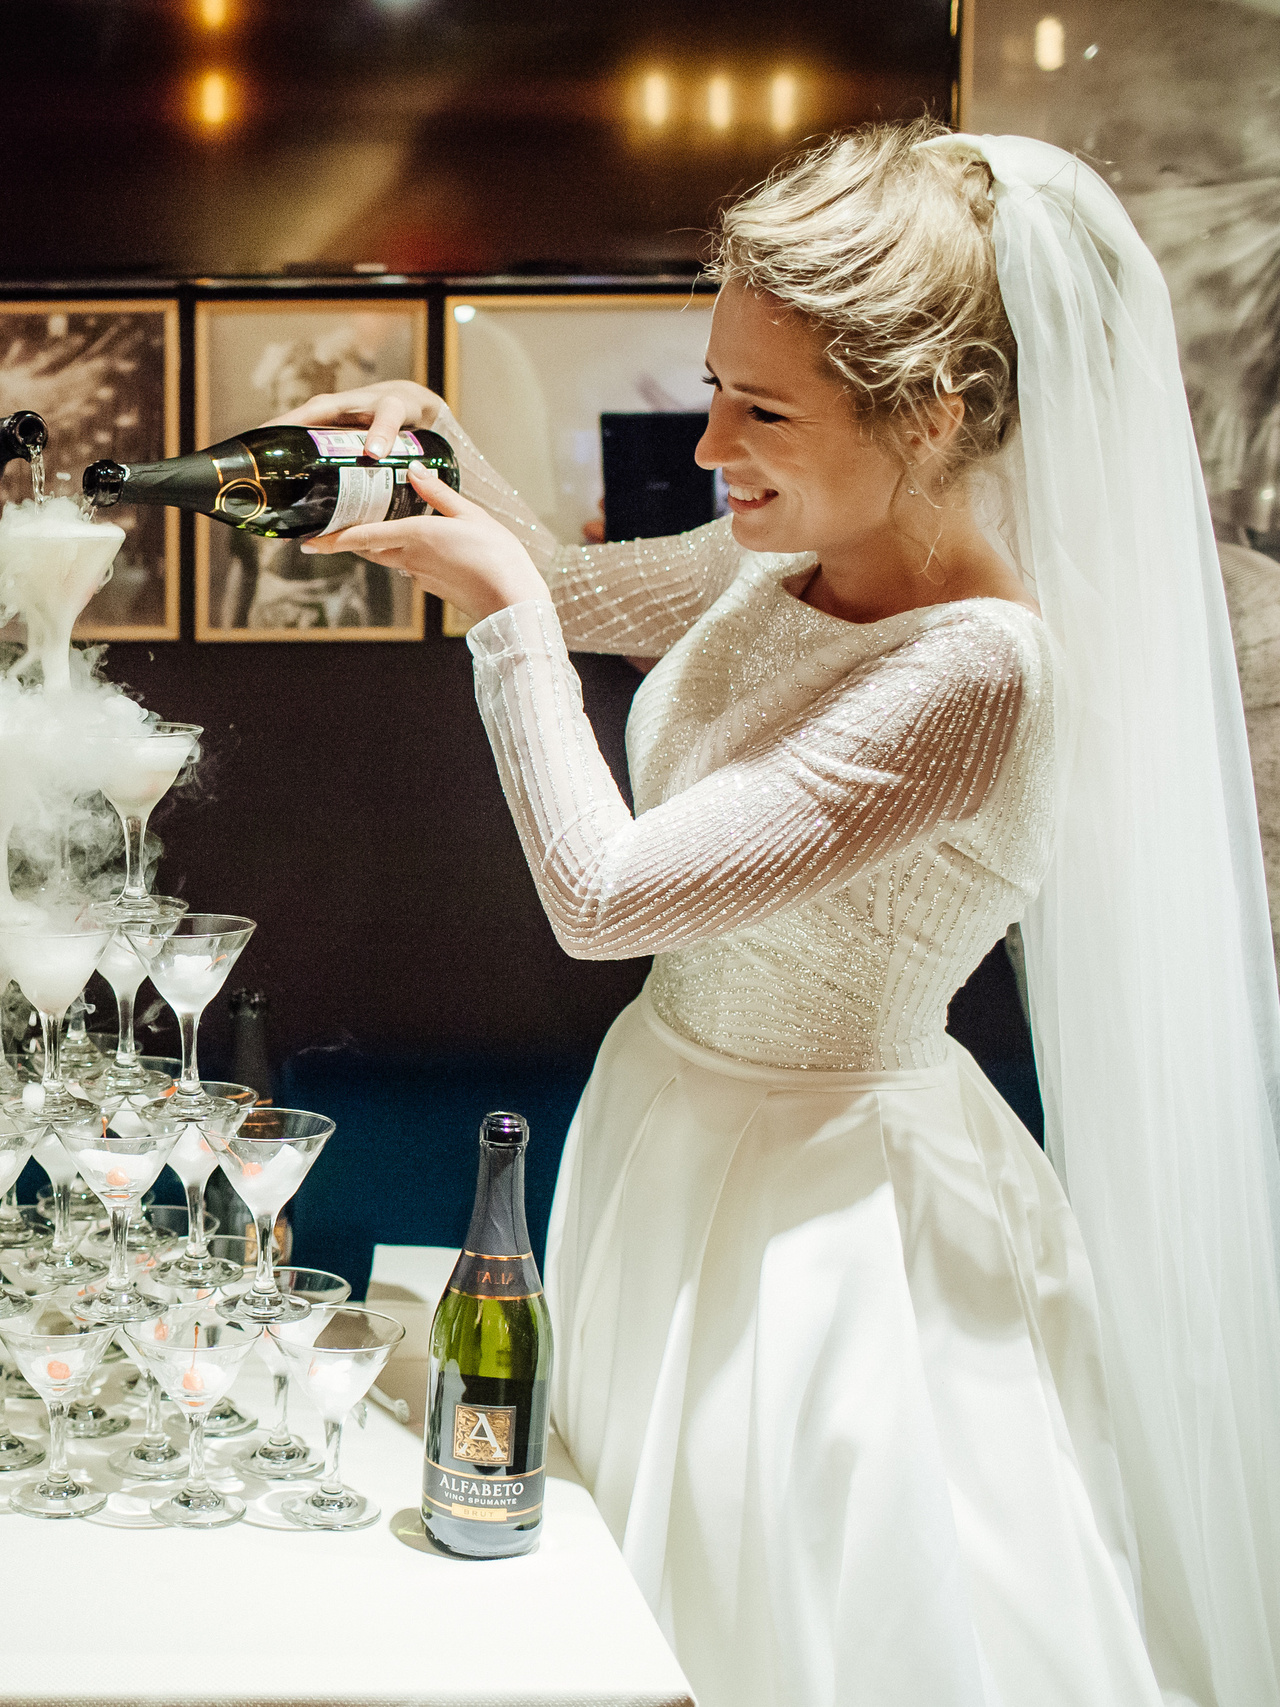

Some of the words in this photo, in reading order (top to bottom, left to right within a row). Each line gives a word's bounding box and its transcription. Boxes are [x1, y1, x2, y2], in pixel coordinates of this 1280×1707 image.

[458, 1412, 506, 1458] A
[439, 1473, 525, 1497] ALFABETO
[444, 1490, 466, 1502] VINO
[467, 1496, 518, 1506] SPUMANTE
[463, 1508, 495, 1518] BRUT
